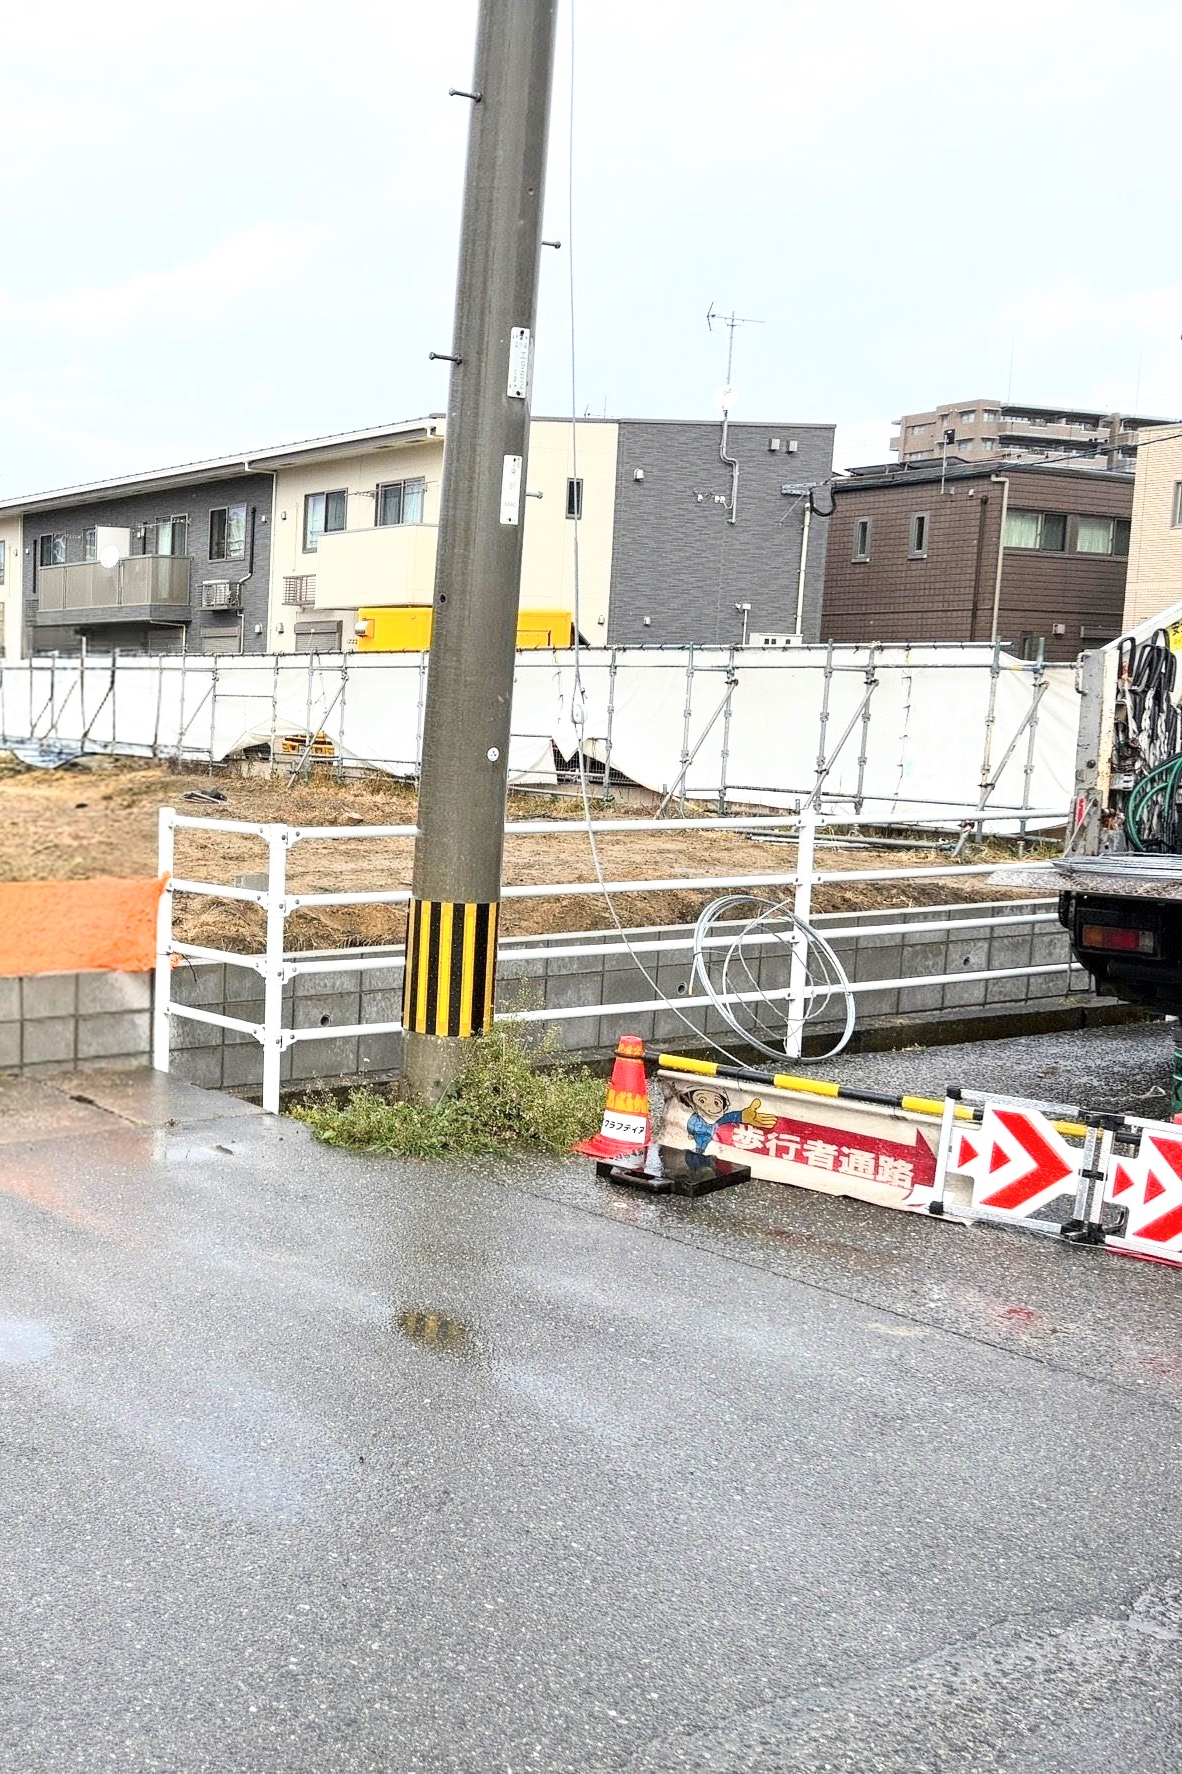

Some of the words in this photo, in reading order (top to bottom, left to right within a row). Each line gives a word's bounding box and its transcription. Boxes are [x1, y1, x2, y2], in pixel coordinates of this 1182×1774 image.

[731, 1124, 915, 1190] 歩行者通路
